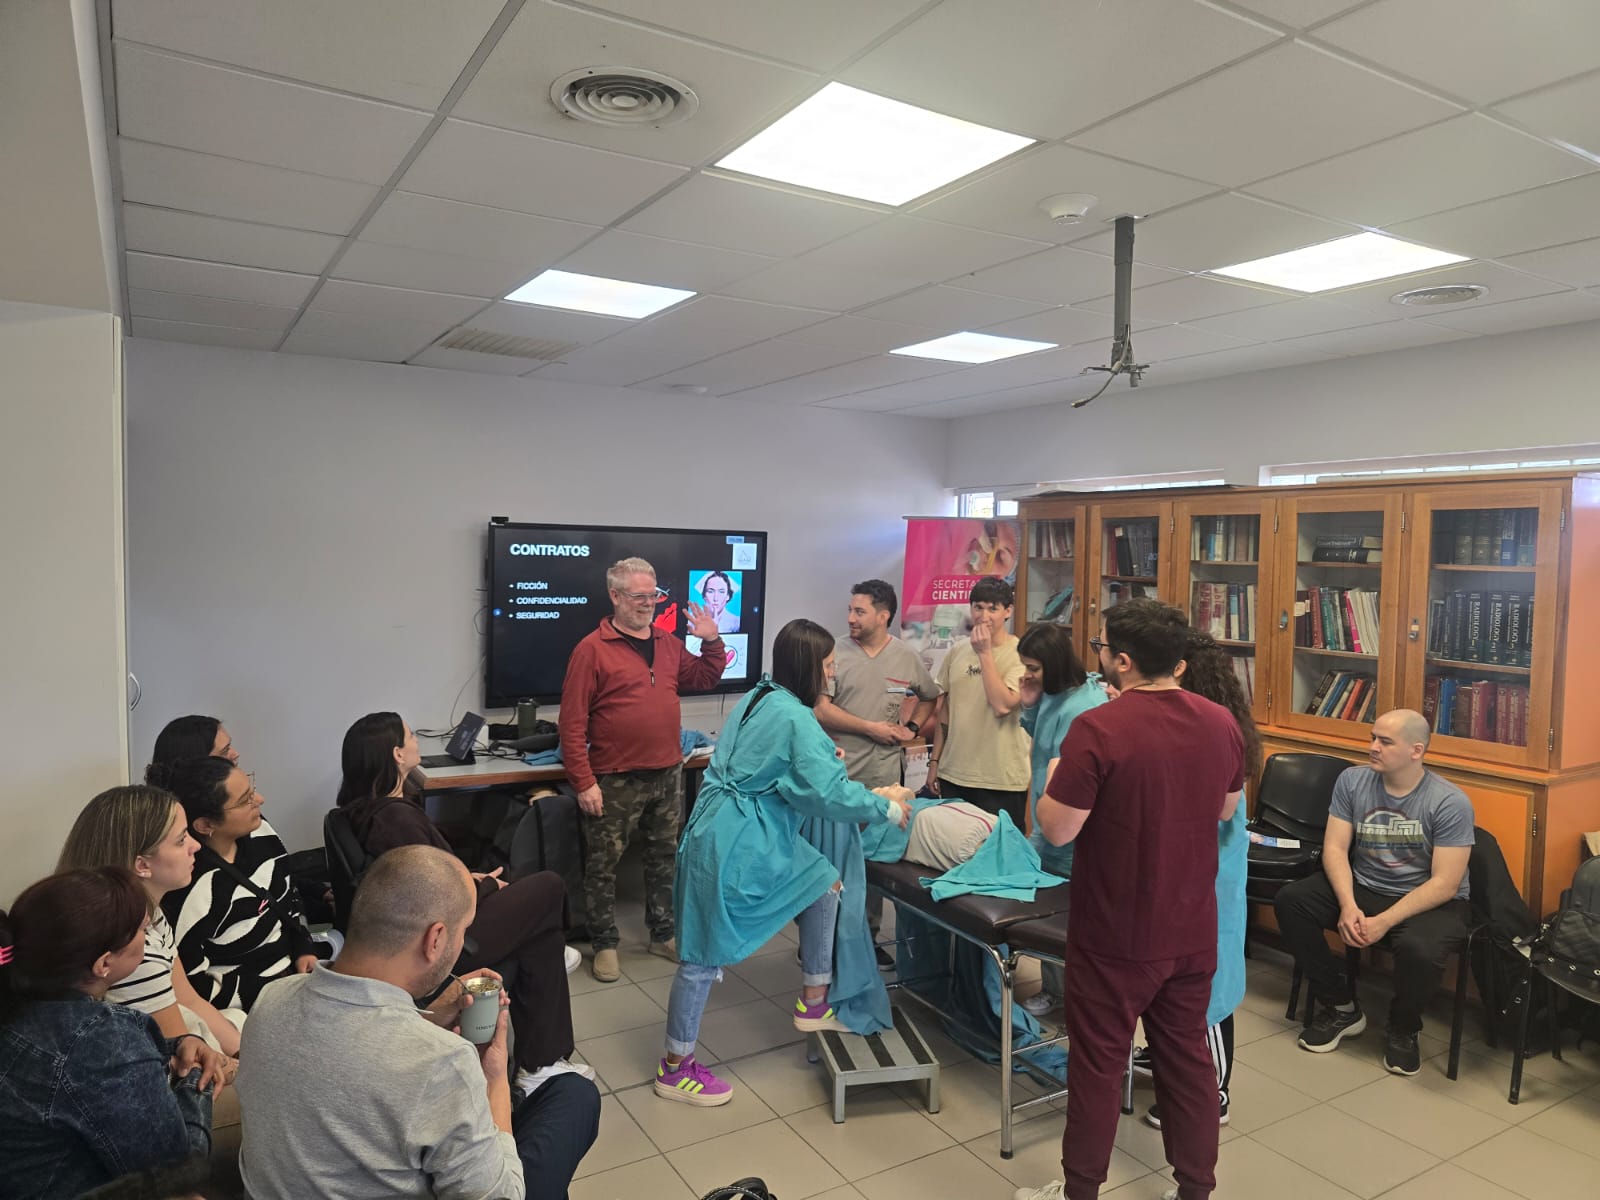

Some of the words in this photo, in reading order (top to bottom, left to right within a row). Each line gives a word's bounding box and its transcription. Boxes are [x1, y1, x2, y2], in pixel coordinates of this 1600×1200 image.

[510, 544, 590, 556] CONTRATOS
[516, 581, 548, 590] FICCIÓN
[933, 579, 977, 589] SECRETA
[932, 590, 971, 600] CIENTI
[516, 597, 588, 605] CONFIDENCIALIDAD
[516, 611, 560, 619] SEGURIDAD
[1472, 601, 1480, 640] RADIOLOGY
[1493, 602, 1502, 641] RADIOLOGY
[1511, 603, 1520, 642] RADIOLOGY
